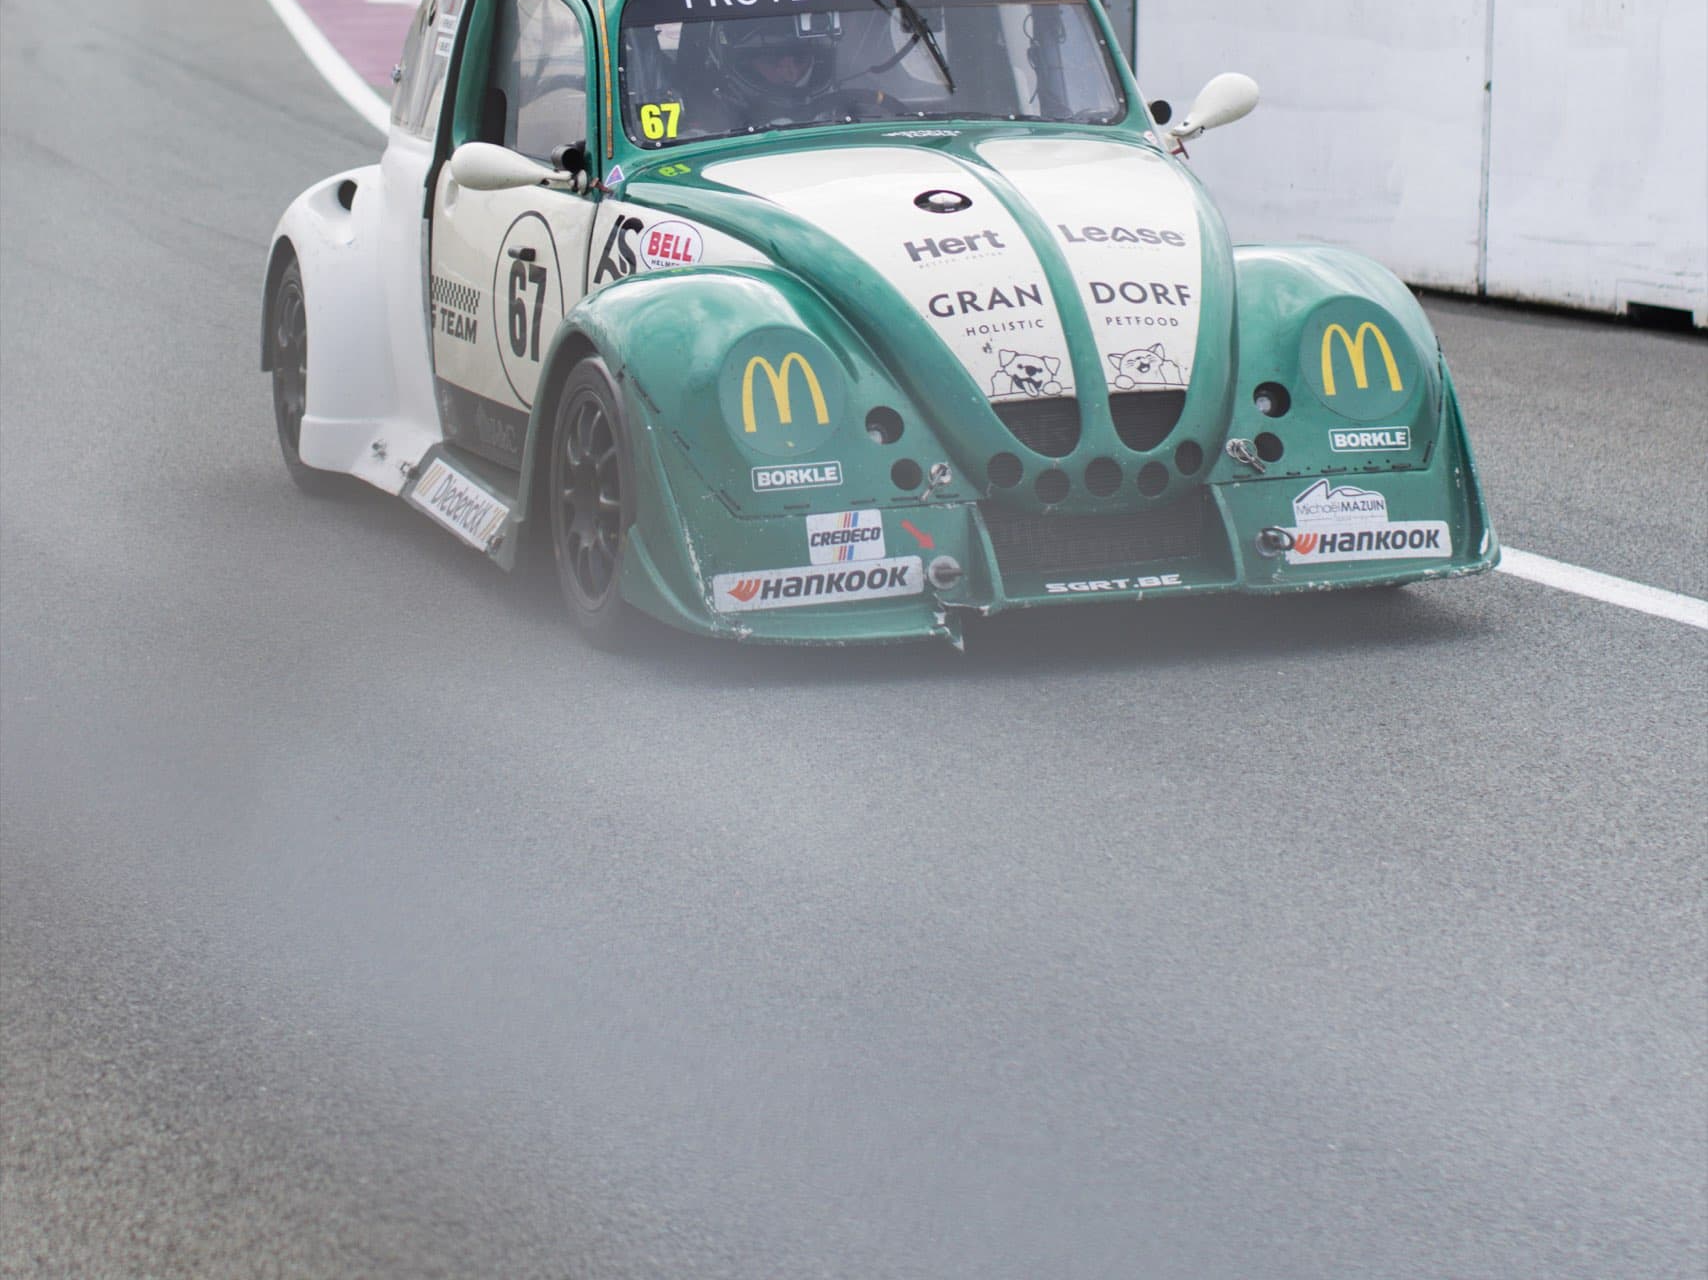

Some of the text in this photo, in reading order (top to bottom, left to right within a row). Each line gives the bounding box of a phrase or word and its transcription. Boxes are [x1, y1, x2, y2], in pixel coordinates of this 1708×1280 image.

[641, 103, 680, 139] 67
[647, 231, 692, 262] BELL
[904, 230, 1005, 262] Hert
[509, 260, 547, 363] 67
[929, 282, 1191, 317] GRAN DORF
[440, 308, 477, 344] TEAM
[966, 317, 1178, 336] HOLISTIC PETFOOD
[1334, 431, 1407, 447] BORKLE
[757, 466, 839, 487] BORKLE
[810, 527, 881, 547] CREDECO
[1045, 574, 1182, 592] SGRT.BE
